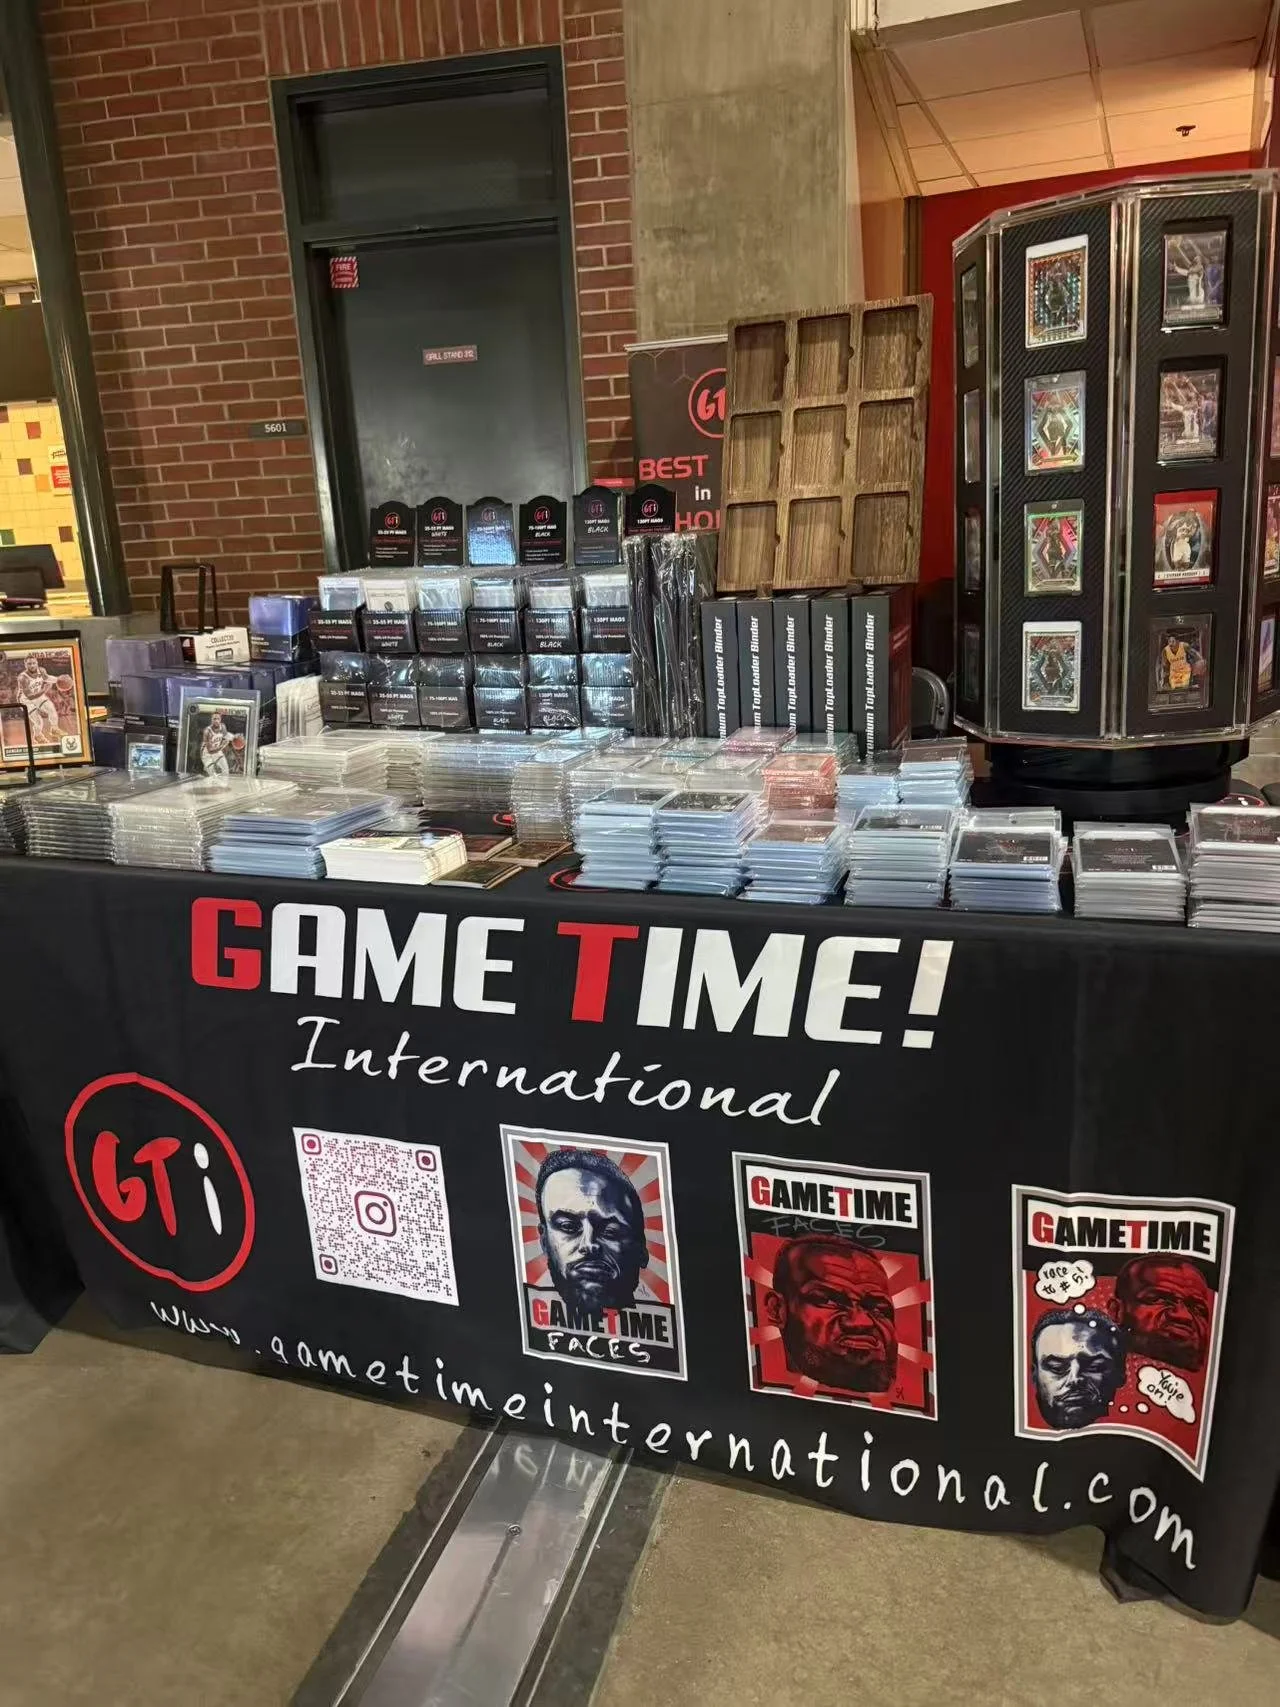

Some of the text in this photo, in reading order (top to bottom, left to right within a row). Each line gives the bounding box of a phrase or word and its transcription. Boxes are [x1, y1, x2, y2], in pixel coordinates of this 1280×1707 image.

[264, 422, 287, 433] 5601
[638, 454, 709, 481] BEST
[694, 485, 711, 501] in
[587, 526, 609, 534] BLACK
[714, 616, 724, 653] Binder
[750, 616, 760, 653] Binder
[785, 614, 796, 652] Binder
[824, 613, 834, 652] Binder
[865, 612, 875, 651] Binder
[715, 653, 727, 711] TopLoader
[751, 653, 762, 711] TopLoader
[787, 653, 798, 711] TopLoader
[824, 653, 835, 711] TopLoader
[865, 652, 876, 710] TopLoader
[191, 896, 954, 1049] GAME TIME!
[290, 1015, 841, 1127] International
[750, 1175, 913, 1223] GAMETIME
[762, 1215, 887, 1248] FACES
[1032, 1211, 1211, 1255] GAMETIME
[1043, 1266, 1068, 1281] race
[532, 1298, 669, 1343] GAMETIME
[546, 1331, 651, 1363] FACES
[150, 1301, 1197, 1570] www.gametimeinternational.com
